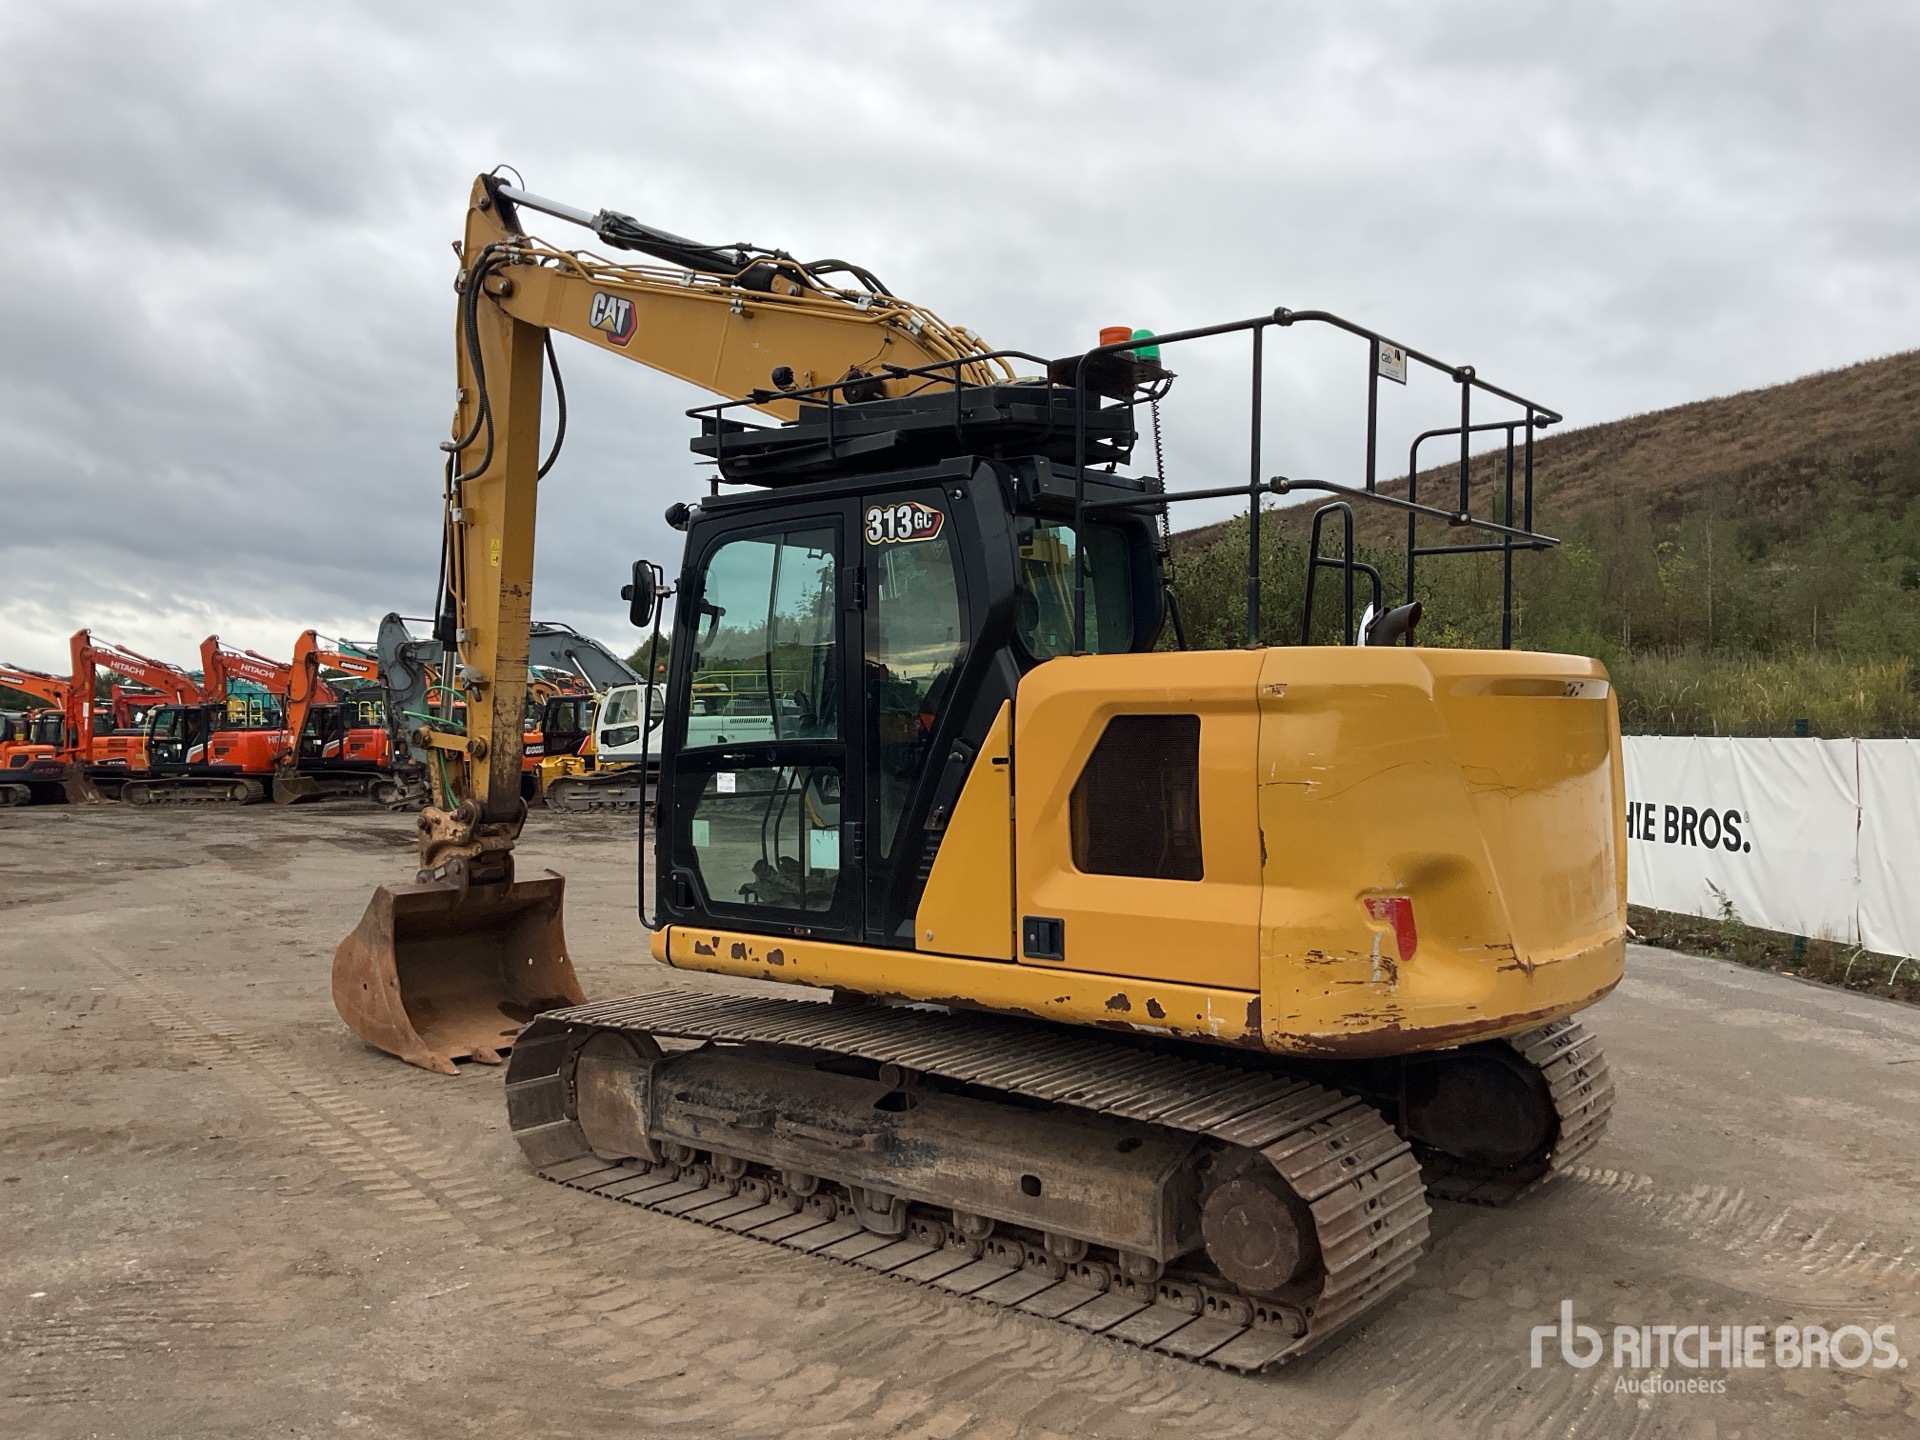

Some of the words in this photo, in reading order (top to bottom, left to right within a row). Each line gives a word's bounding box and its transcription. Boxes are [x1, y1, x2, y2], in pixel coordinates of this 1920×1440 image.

[590, 292, 630, 334] CAT
[110, 661, 145, 676] HITACHI
[241, 663, 275, 678] HITACHI
[341, 662, 368, 671] DOOSAN
[1664, 804, 1751, 853] BROS.
